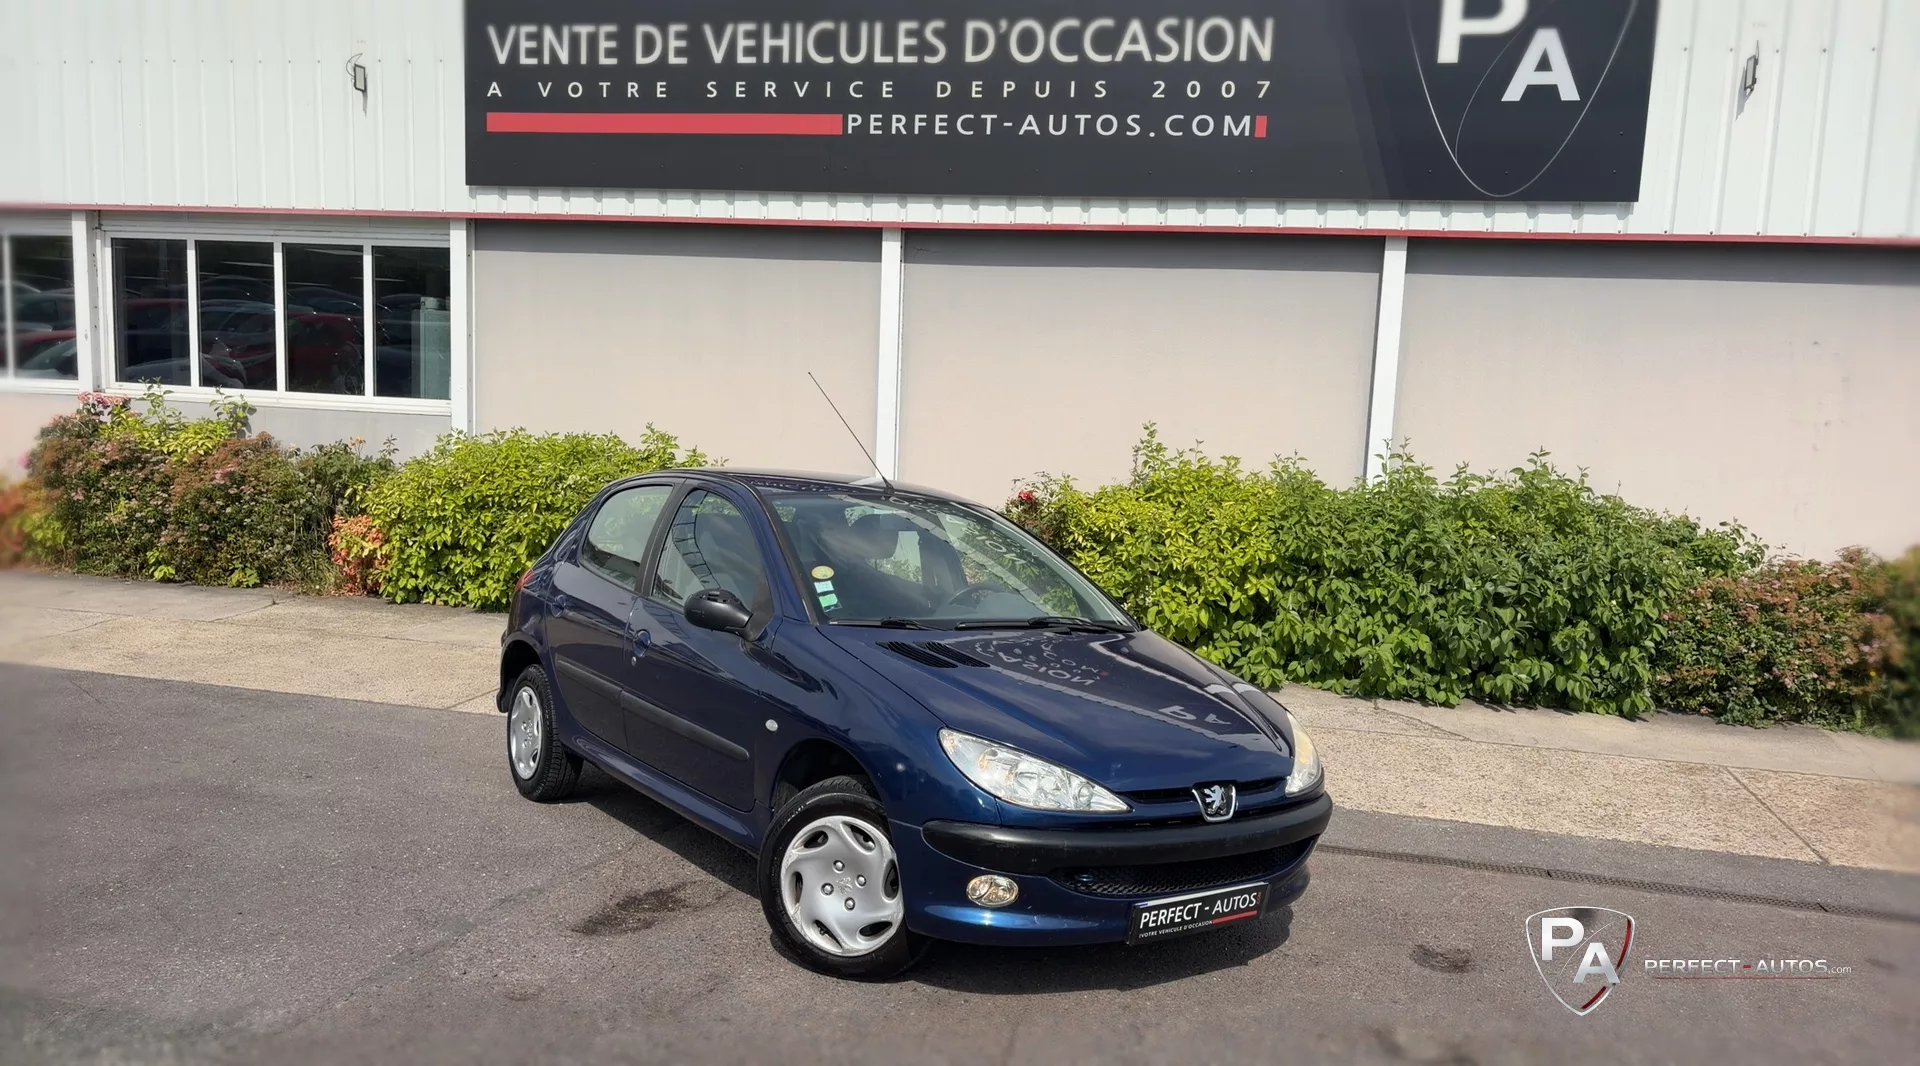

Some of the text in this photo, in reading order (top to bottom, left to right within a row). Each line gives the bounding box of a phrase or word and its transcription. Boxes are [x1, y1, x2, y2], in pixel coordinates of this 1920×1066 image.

[487, 17, 1274, 65] VENTE DE VEHICULES D'OCCASION
[487, 80, 1271, 99] A VOTRE SERVICE DEPUIS 2007
[846, 113, 1252, 138] PERFECT-AUTOS.COM
